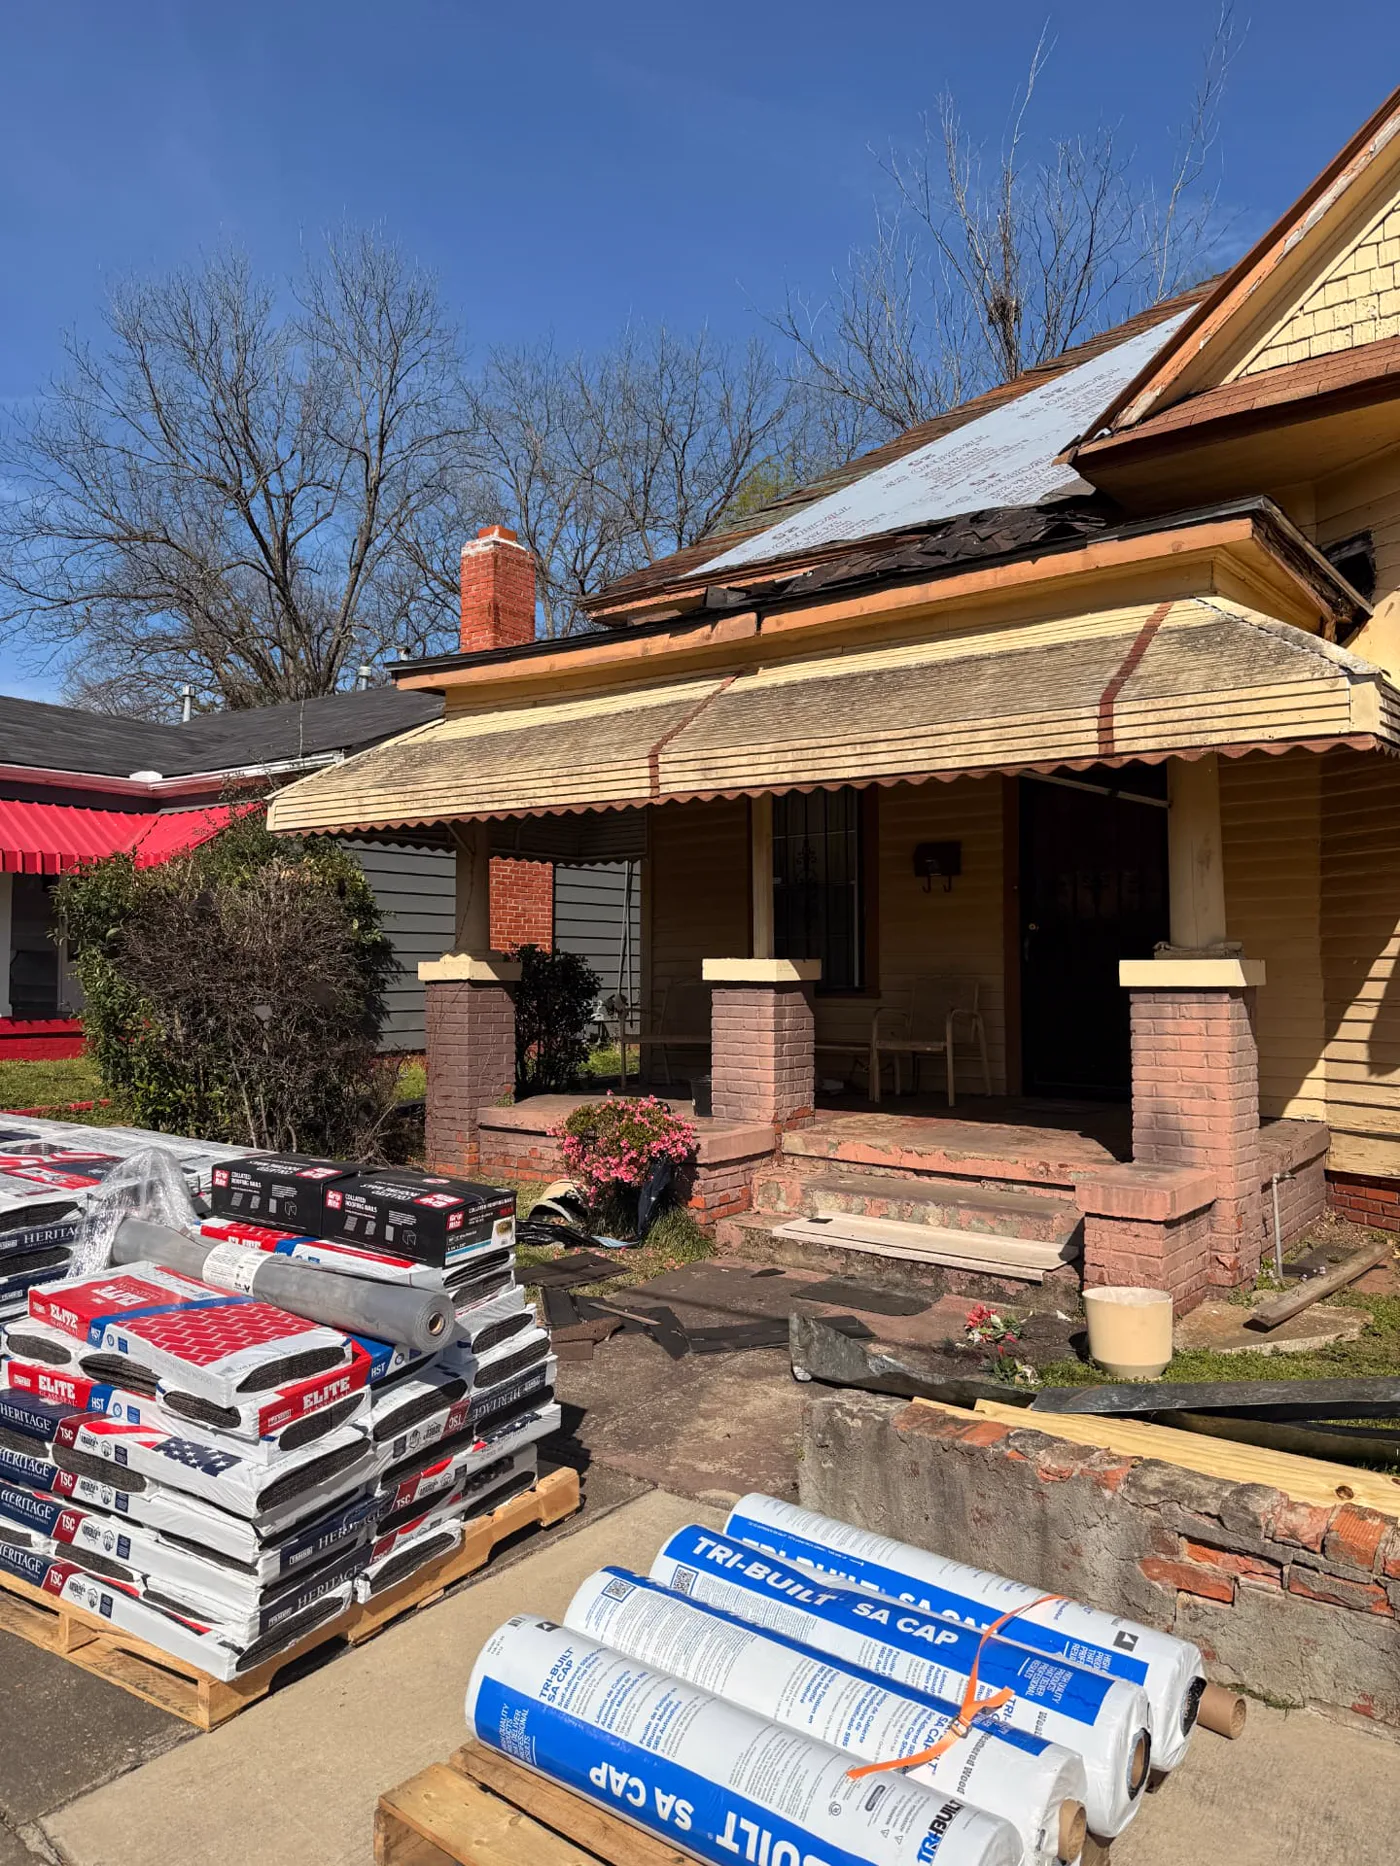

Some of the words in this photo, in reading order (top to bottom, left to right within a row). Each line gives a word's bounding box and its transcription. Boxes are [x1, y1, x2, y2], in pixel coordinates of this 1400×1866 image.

[371, 1362, 386, 1378] HST
[38, 1375, 76, 1400] ELITE
[303, 1376, 351, 1410] ELITE
[91, 1396, 105, 1411] HST
[0, 1403, 52, 1432] HERITAGE
[60, 1427, 74, 1440] TSC
[0, 1447, 52, 1477] HERITAGE
[60, 1471, 73, 1487] TSC
[1, 1490, 55, 1520] HERITAGE
[62, 1514, 76, 1530] TSC
[50, 1570, 63, 1587] TSC
[297, 1562, 364, 1610] HERITAGE
[691, 1536, 839, 1607] TRI-BUILT
[852, 1603, 890, 1625] SA
[896, 1614, 960, 1647] CAP
[539, 1646, 574, 1697] TRI-BUILT
[547, 1684, 560, 1703] SA
[557, 1660, 574, 1683] CAP
[811, 1690, 826, 1715] Finition
[499, 1703, 509, 1736] QUALITY
[807, 1714, 815, 1724] en
[855, 1721, 863, 1731] de
[934, 1716, 947, 1730] SA
[841, 1731, 851, 1747] SBS
[903, 1725, 916, 1741] Cap
[589, 1760, 647, 1797] CAP
[957, 1766, 973, 1795] Wood
[653, 1786, 695, 1831] SA
